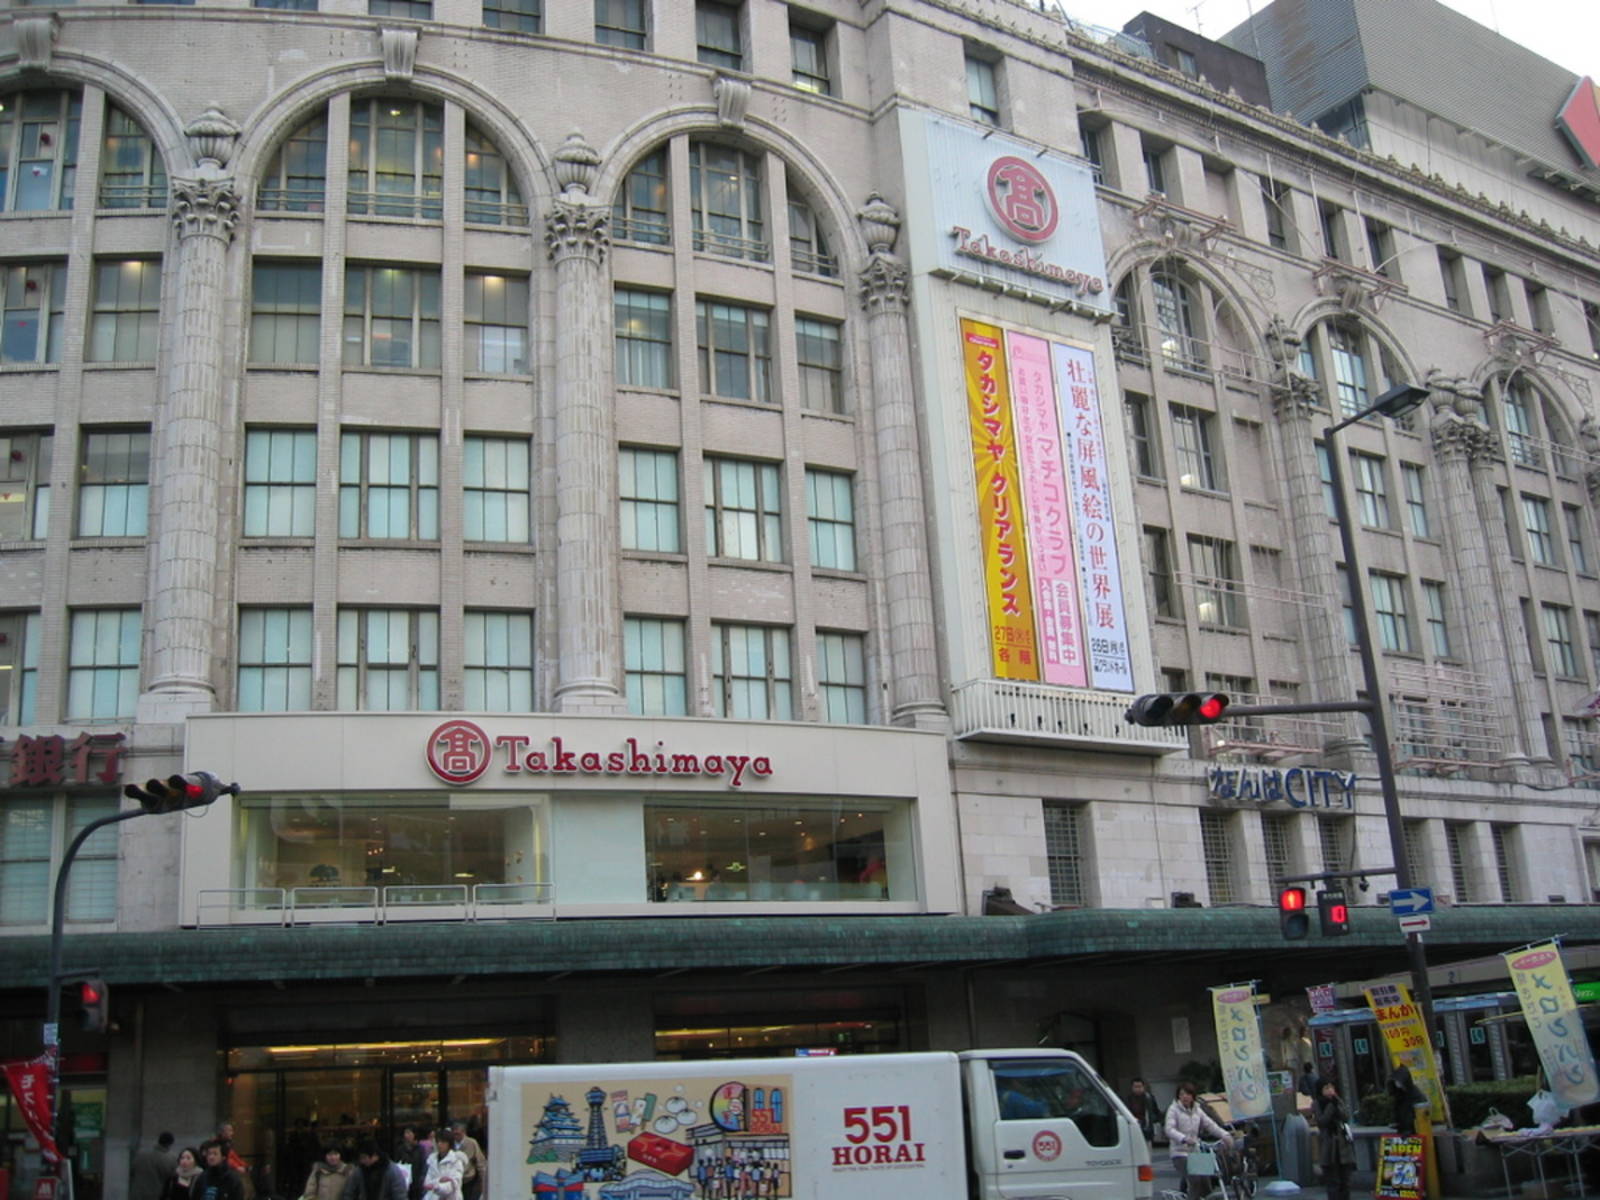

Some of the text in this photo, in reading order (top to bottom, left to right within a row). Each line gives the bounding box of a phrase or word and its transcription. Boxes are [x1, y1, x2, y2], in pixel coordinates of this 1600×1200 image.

[952, 226, 1104, 294] Takashimaya
[1066, 358, 1115, 630] 壮麗な屏風絵の世界展
[1055, 582, 1077, 663] 会員募集中
[9, 731, 127, 784] 銀行
[496, 735, 774, 787] Takashimaya
[1375, 1004, 1414, 1022] まんが
[843, 1105, 911, 1145] 551
[831, 1143, 926, 1166] HORAI
